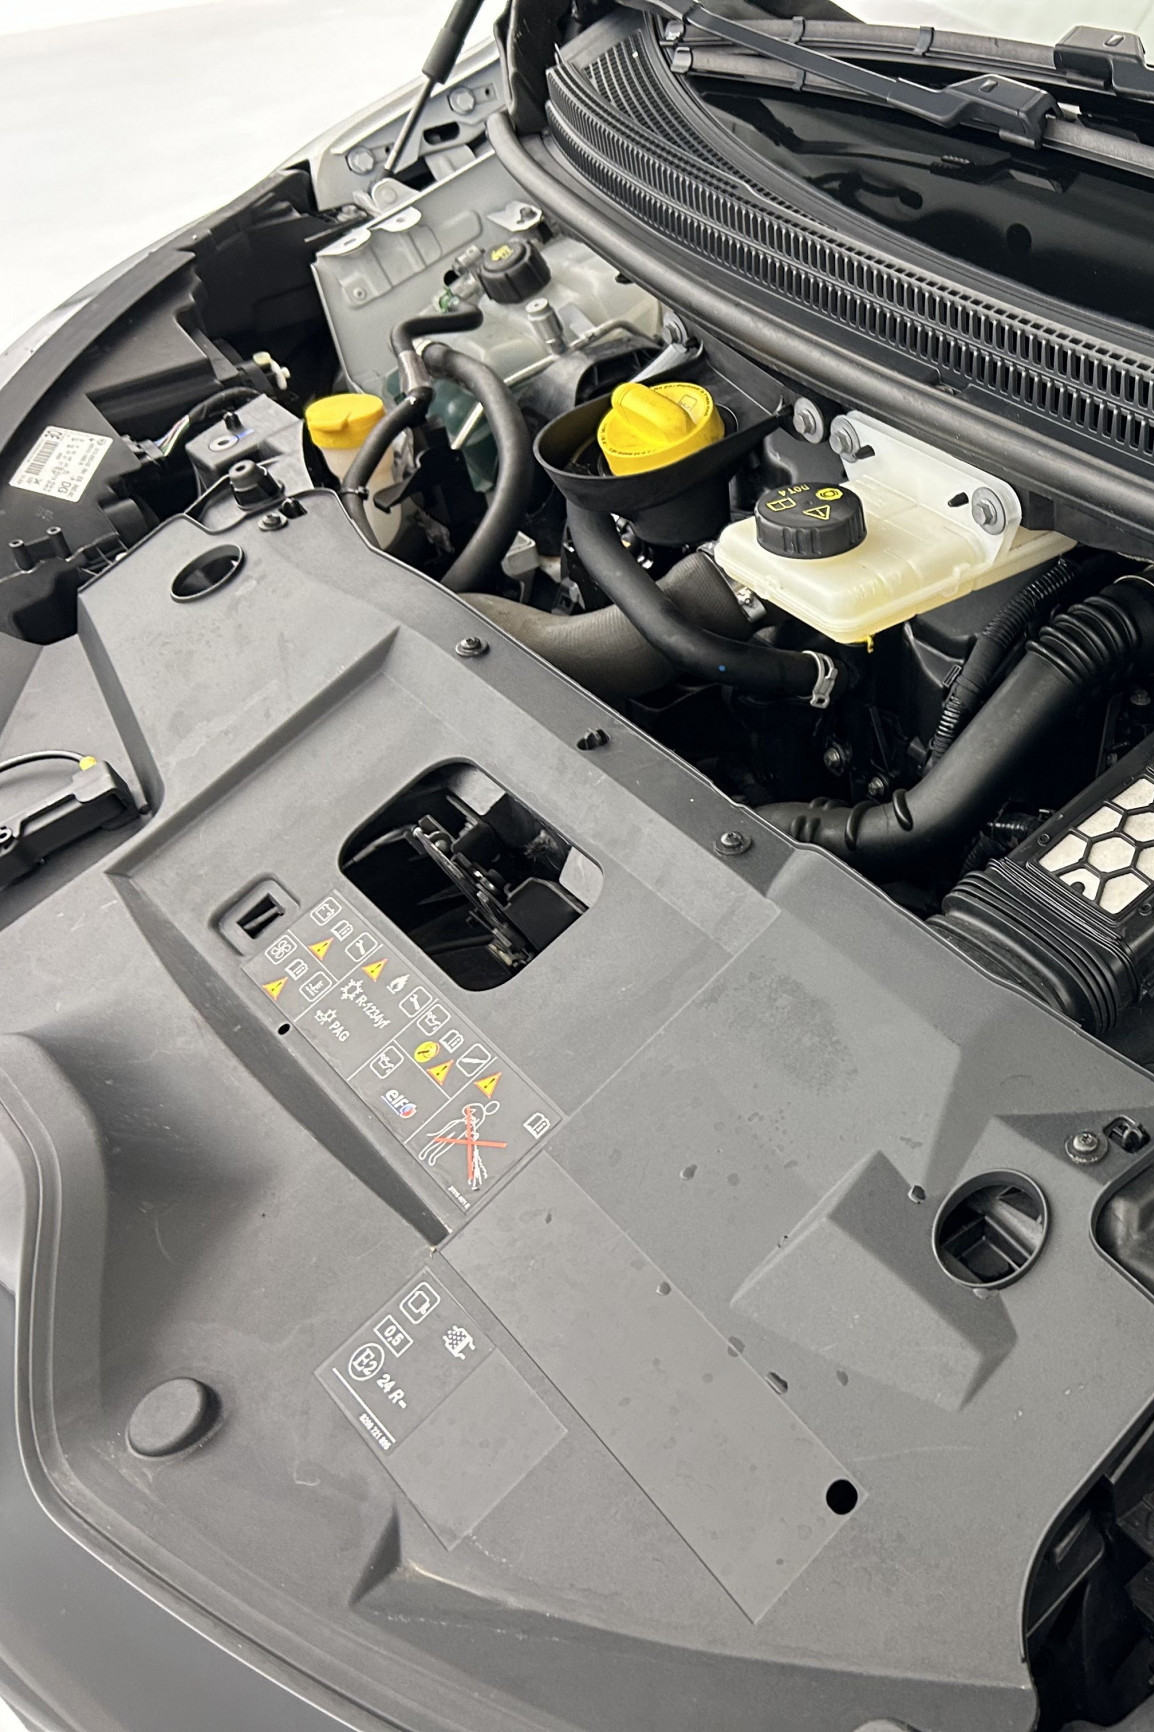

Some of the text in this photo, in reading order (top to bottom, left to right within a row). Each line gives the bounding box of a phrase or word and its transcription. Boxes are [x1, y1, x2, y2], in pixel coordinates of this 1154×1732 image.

[355, 994, 391, 1029] R-1234yf
[328, 1020, 350, 1042] PAG
[385, 1089, 409, 1111] elf
[383, 1324, 404, 1346] 0,5
[353, 1348, 378, 1375] E2
[376, 1373, 396, 1393] 24
